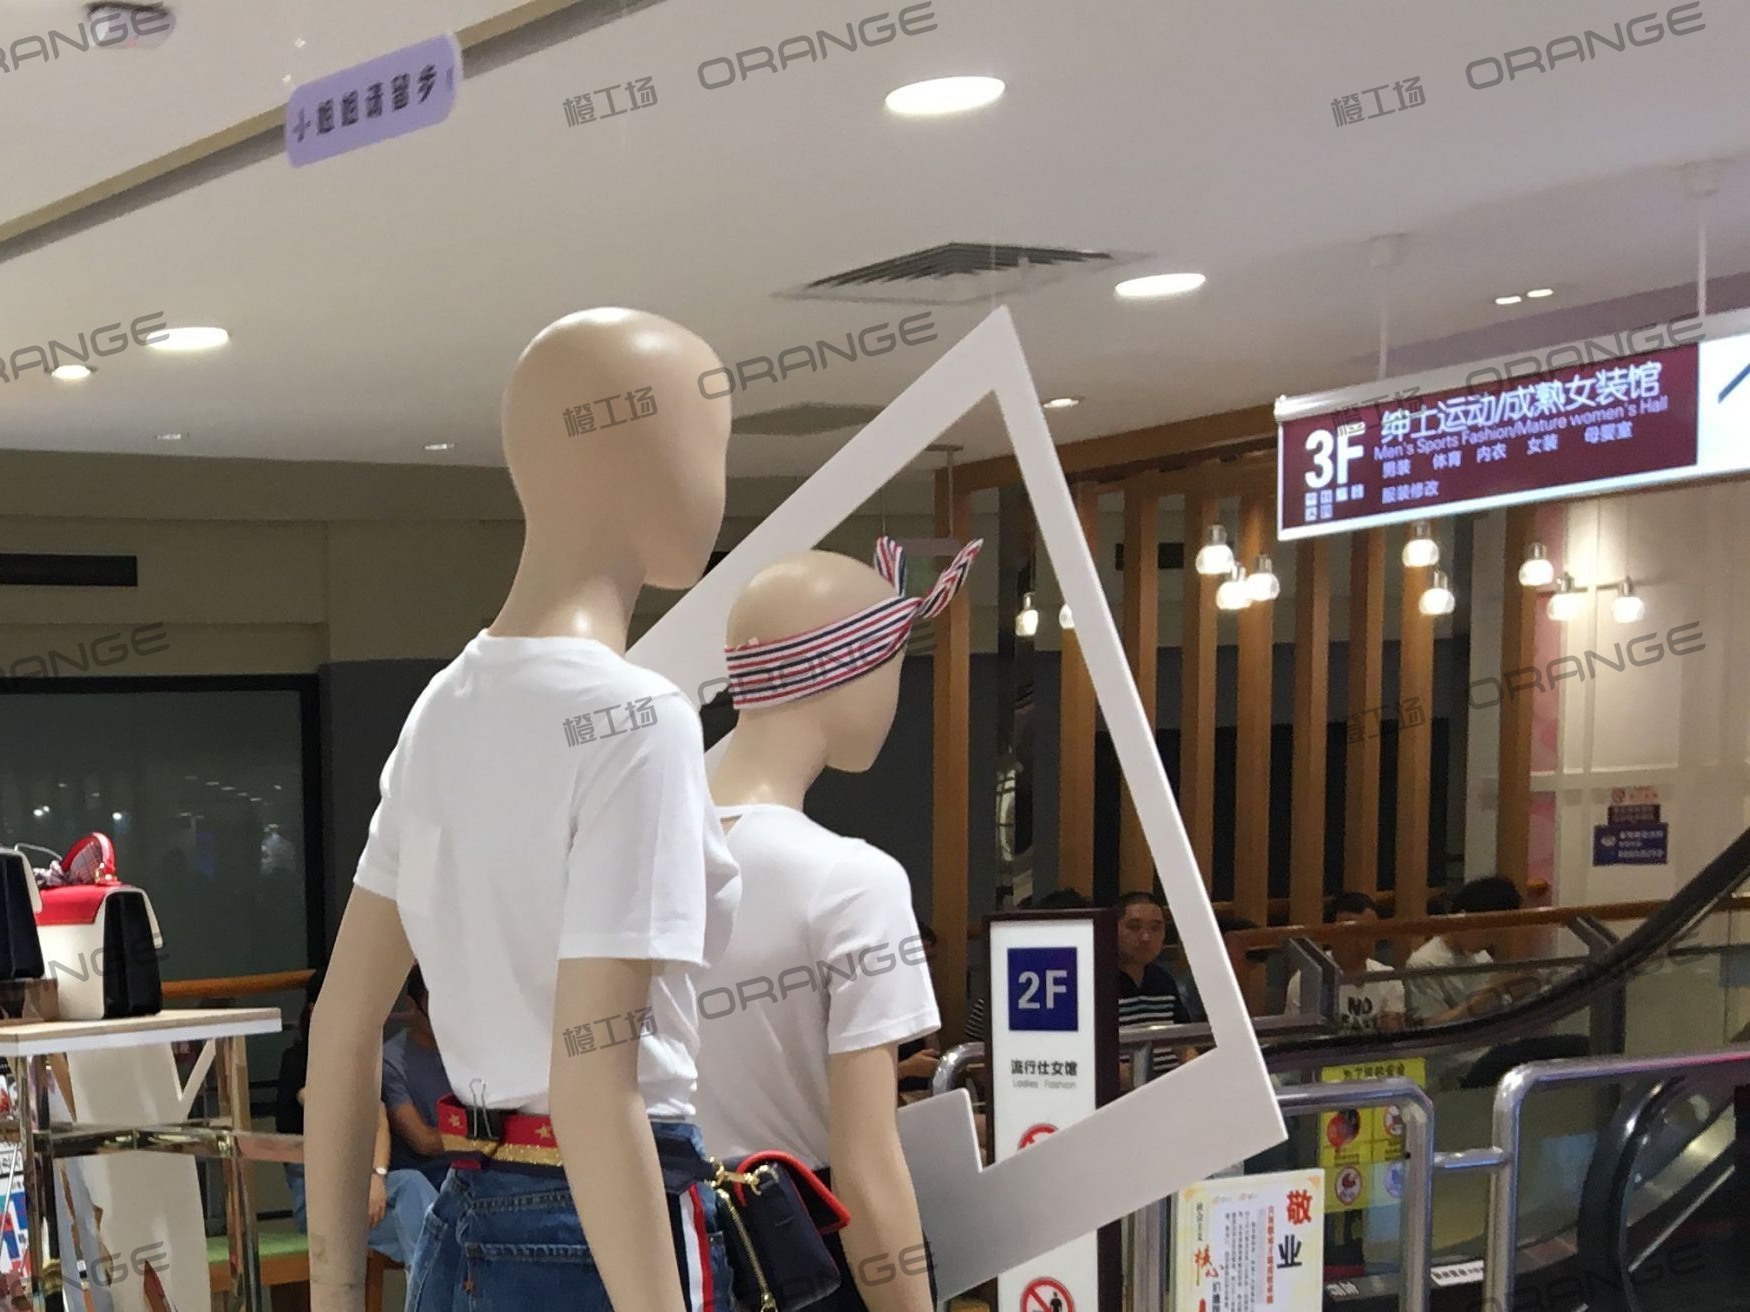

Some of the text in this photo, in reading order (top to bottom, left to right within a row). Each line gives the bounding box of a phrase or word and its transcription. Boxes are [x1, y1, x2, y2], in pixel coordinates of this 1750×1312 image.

[1374, 396, 1668, 461] Men's Sports Fashion/Mature women's Hall
[1381, 361, 1662, 443] 绅士运动/成熟女装馆
[1305, 423, 1367, 488] 3F
[1477, 444, 1506, 462] 内衣
[1526, 435, 1559, 456] 女装
[1018, 969, 1068, 1010] 2F
[1011, 1059, 1079, 1077] 流行仕女馆
[1277, 1190, 1313, 1269] 敬业
